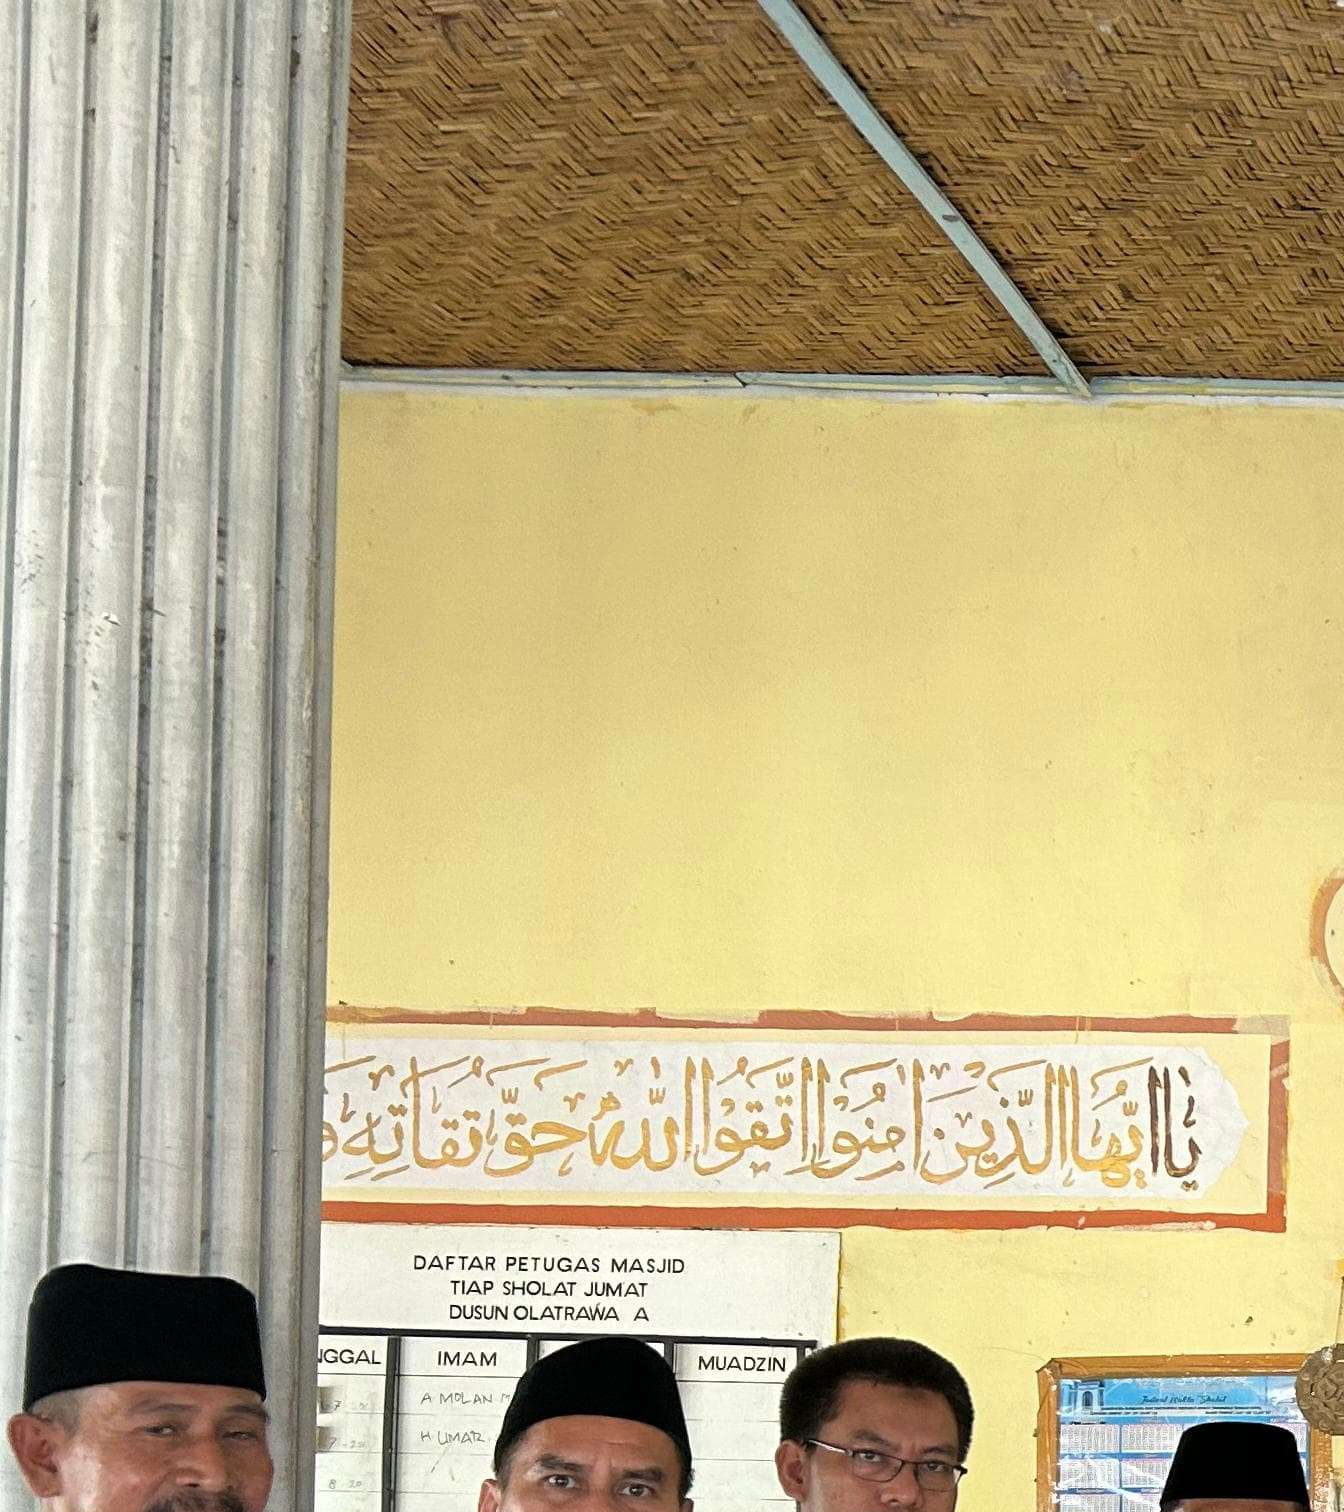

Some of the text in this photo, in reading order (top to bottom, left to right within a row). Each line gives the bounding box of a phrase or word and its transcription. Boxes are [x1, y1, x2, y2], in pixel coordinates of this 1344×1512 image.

[413, 1255, 685, 1274] DAFTAR PETUGAS MASJID
[450, 1280, 494, 1296] TIAP
[502, 1280, 577, 1297] SHOLAT
[449, 1304, 650, 1322] DUSUN OLATRAWA A
[437, 1350, 498, 1367] IMAM
[698, 1355, 786, 1372] MUADZIN
